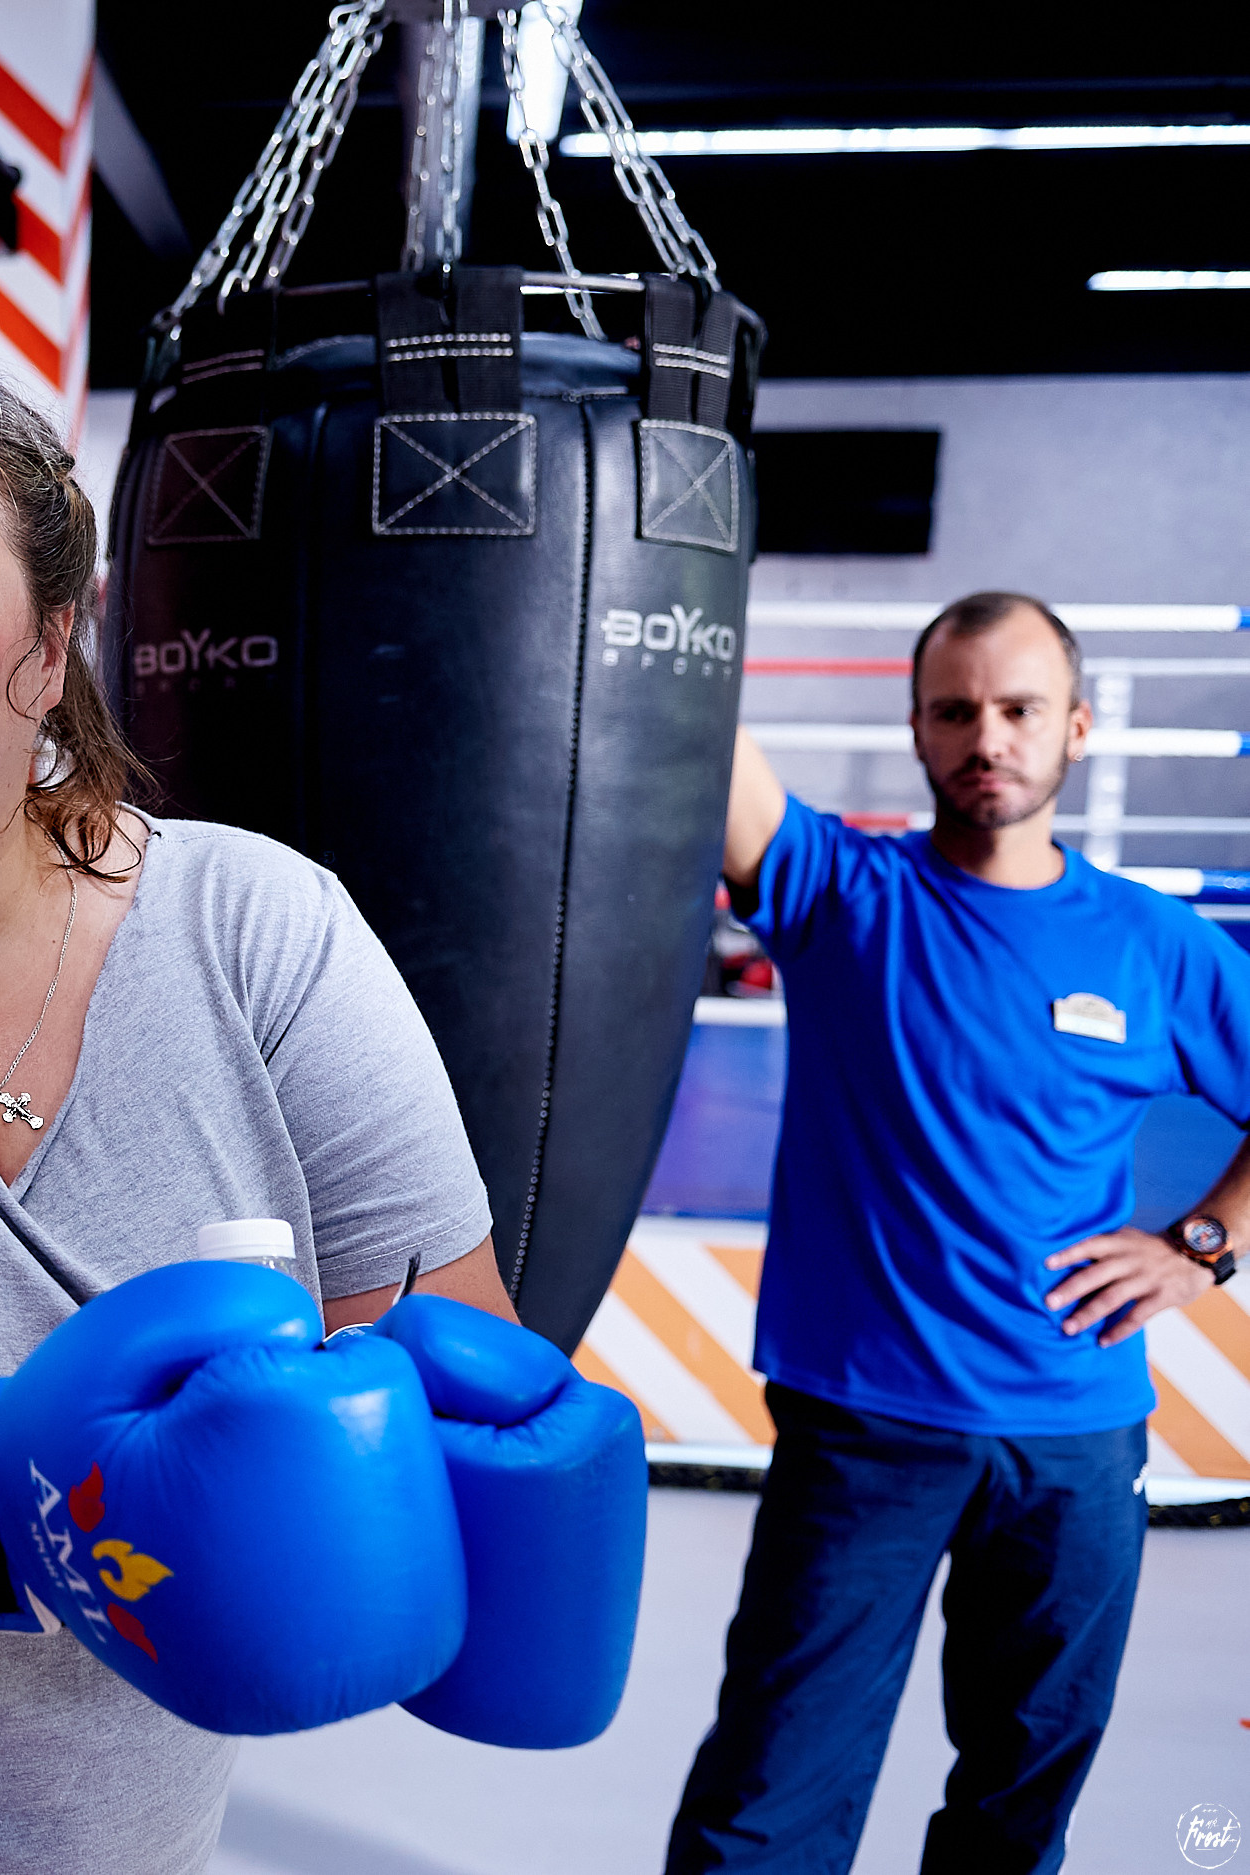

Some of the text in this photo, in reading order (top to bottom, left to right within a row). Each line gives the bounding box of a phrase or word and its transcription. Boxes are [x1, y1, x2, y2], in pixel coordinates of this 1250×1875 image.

[134, 628, 278, 677] BOYKO
[601, 604, 736, 662] BOYKO
[29, 1457, 113, 1643] AML
